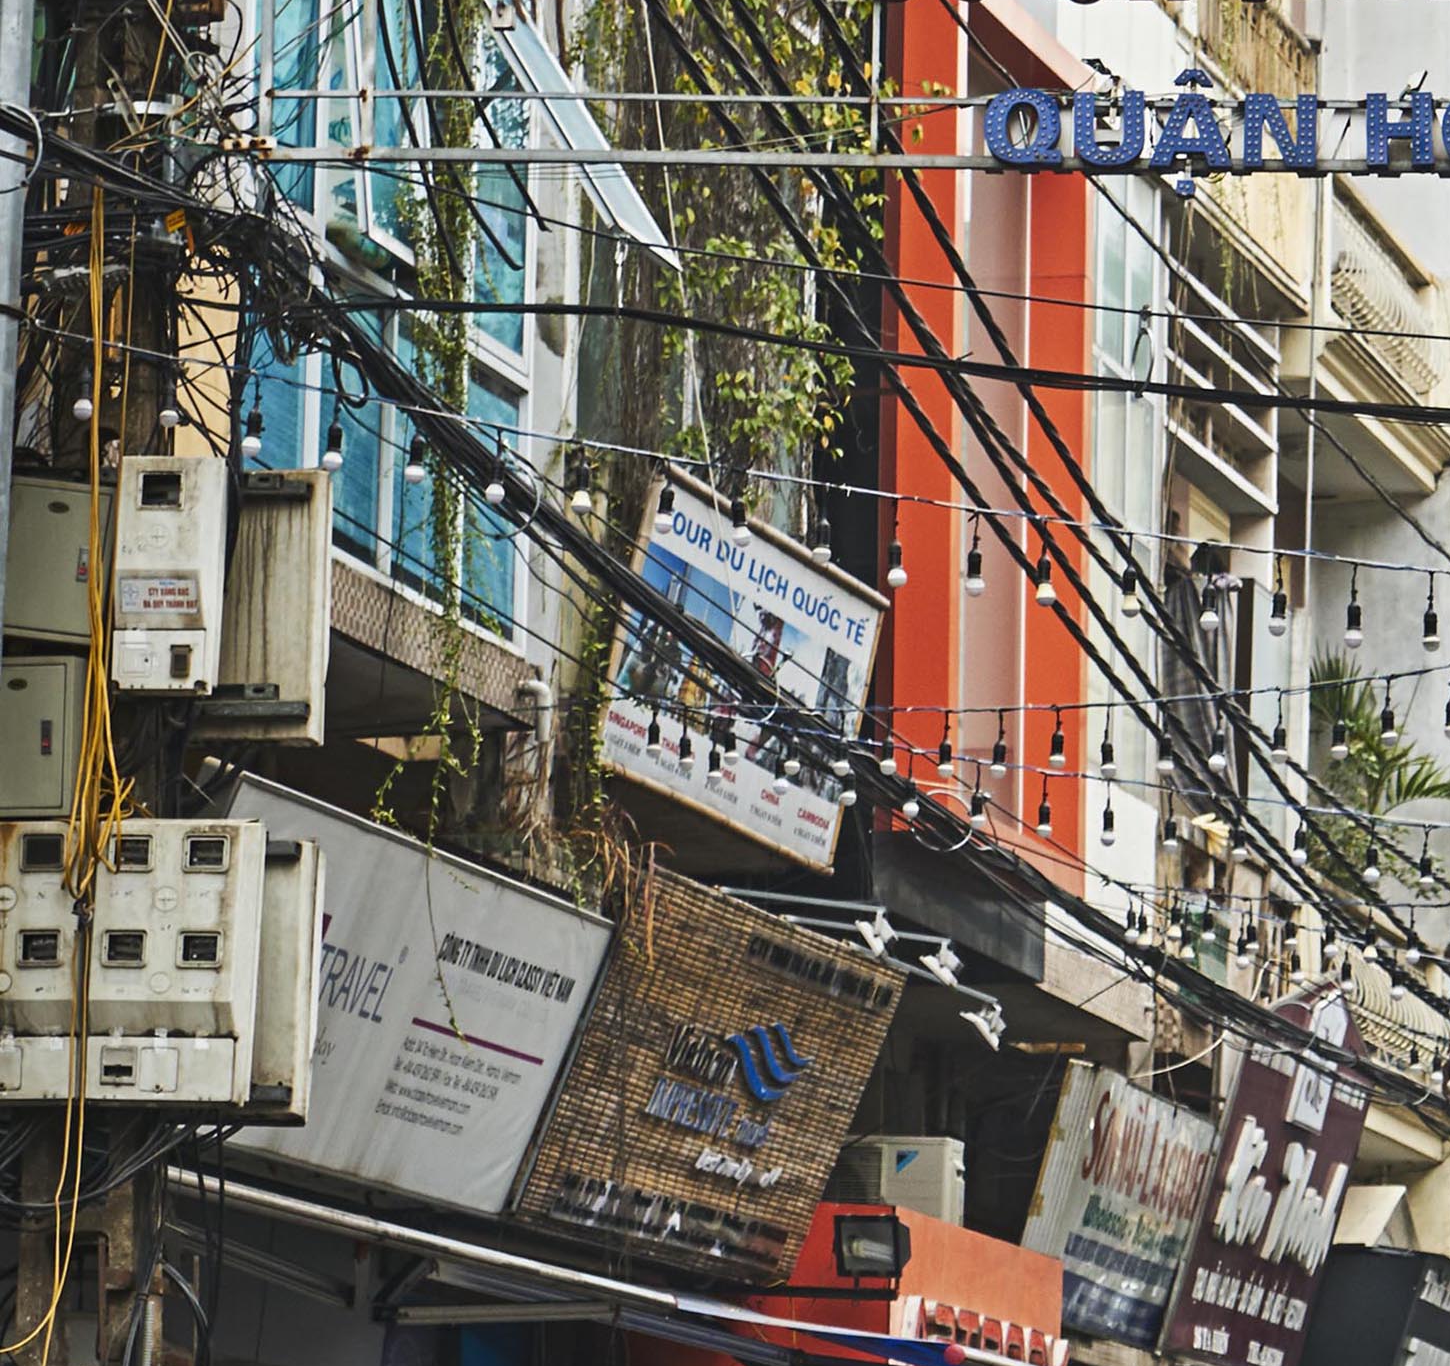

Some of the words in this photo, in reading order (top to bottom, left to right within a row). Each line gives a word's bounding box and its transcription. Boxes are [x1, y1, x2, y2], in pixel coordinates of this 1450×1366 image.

[984, 67, 1320, 197] QUẬN
[671, 510, 713, 553] OUR
[319, 943, 394, 1025] TRAVEL
